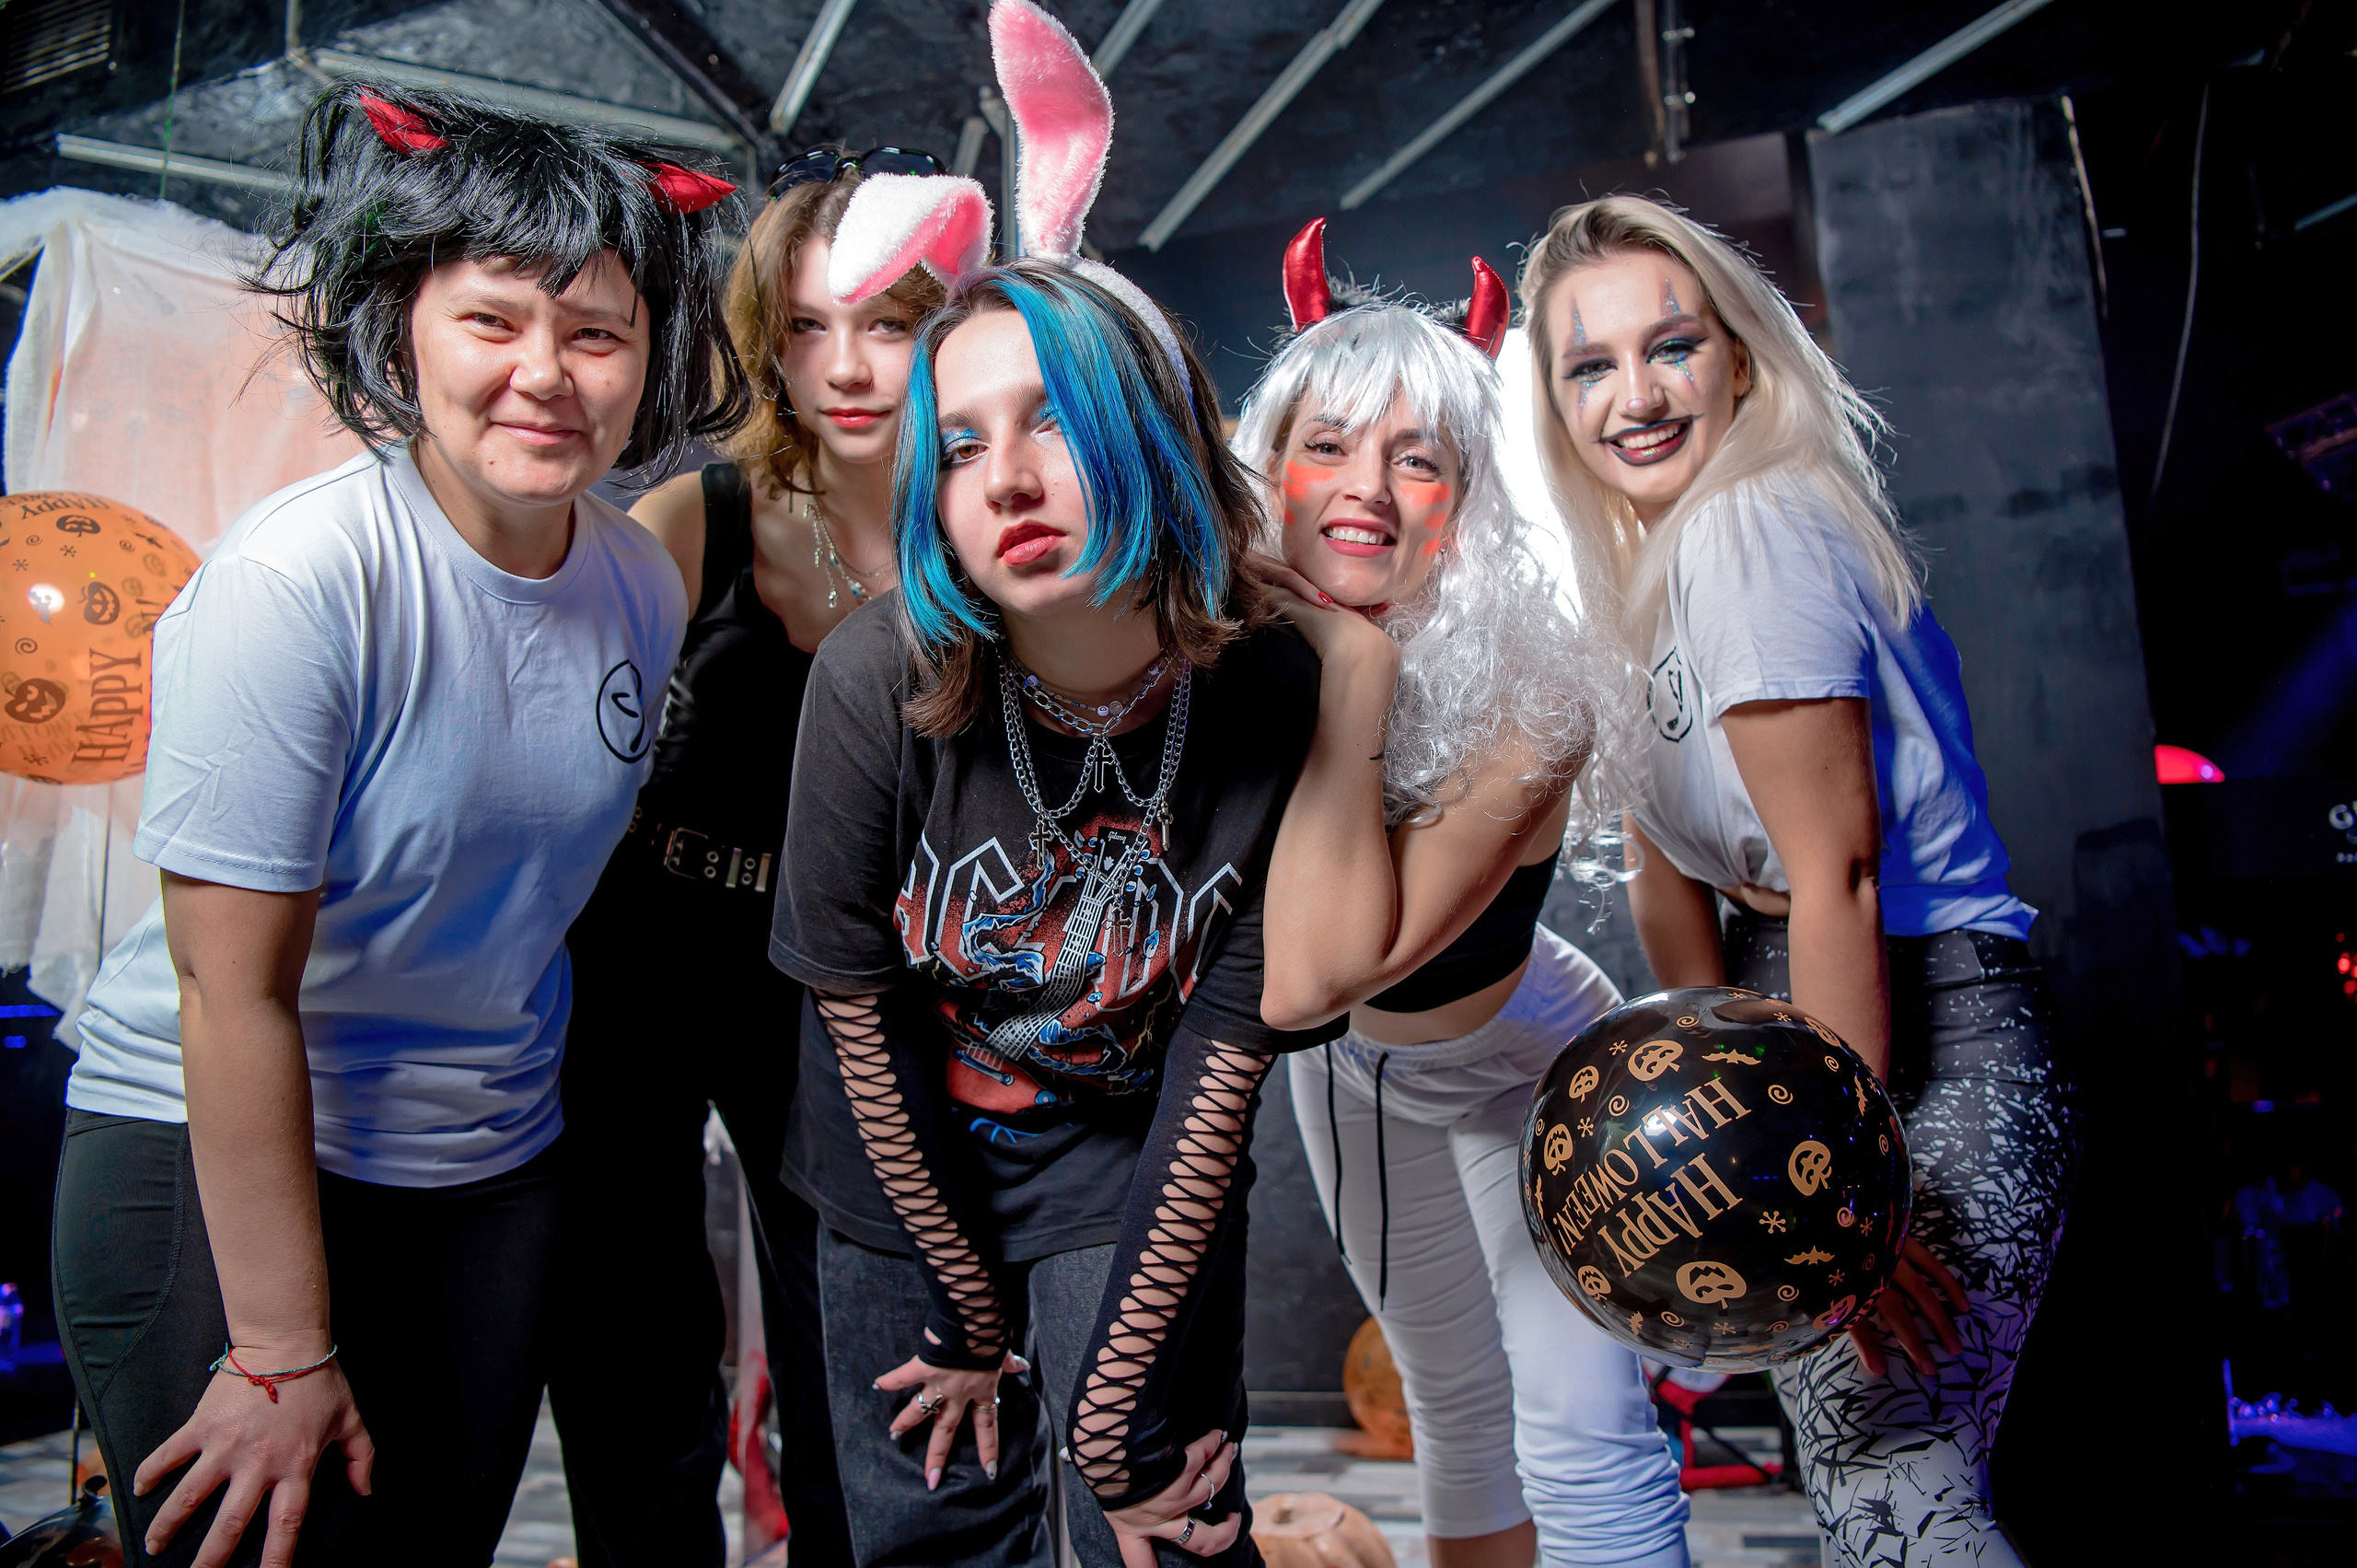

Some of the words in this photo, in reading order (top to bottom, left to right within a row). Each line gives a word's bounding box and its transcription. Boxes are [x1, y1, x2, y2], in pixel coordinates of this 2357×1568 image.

[72, 647, 144, 764] HAPPY
[1552, 1076, 1752, 1256] HALLOWEEN!
[1596, 1152, 1744, 1278] HAPPY
